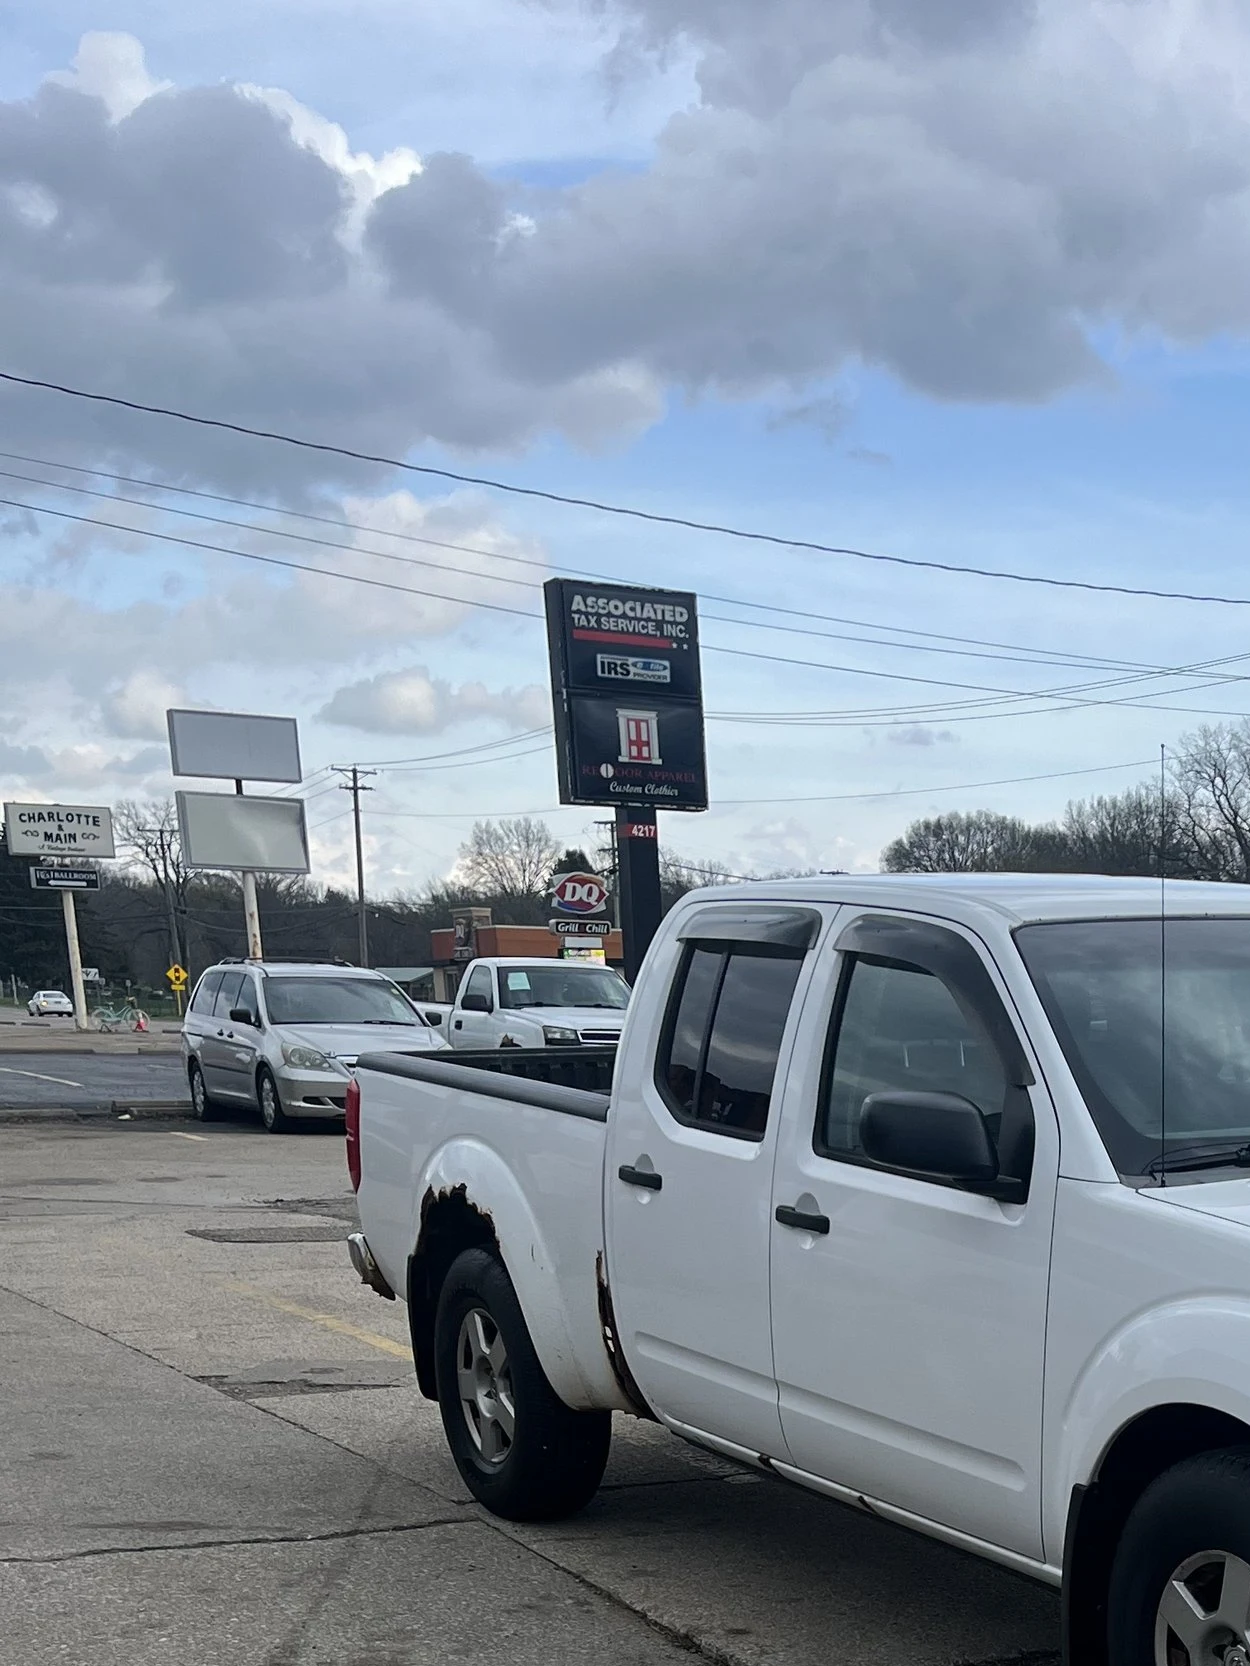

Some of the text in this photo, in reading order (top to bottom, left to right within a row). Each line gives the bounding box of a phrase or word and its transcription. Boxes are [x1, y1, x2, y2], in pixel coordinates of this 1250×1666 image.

[571, 595, 689, 622] ASSOCIATED
[571, 613, 690, 639] TAX SERVICE, INC.
[600, 660, 631, 677] IRS
[645, 770, 696, 784] APPAREL
[610, 781, 679, 796] Custom Clothier
[18, 811, 101, 827] CHARLOTTE
[57, 823, 65, 832] &
[631, 824, 656, 837] 4217
[43, 831, 77, 844] MAIN
[54, 872, 97, 880] BALLROOM
[563, 882, 600, 905] DQ
[557, 923, 579, 933] Grill
[585, 924, 608, 934] Chill
